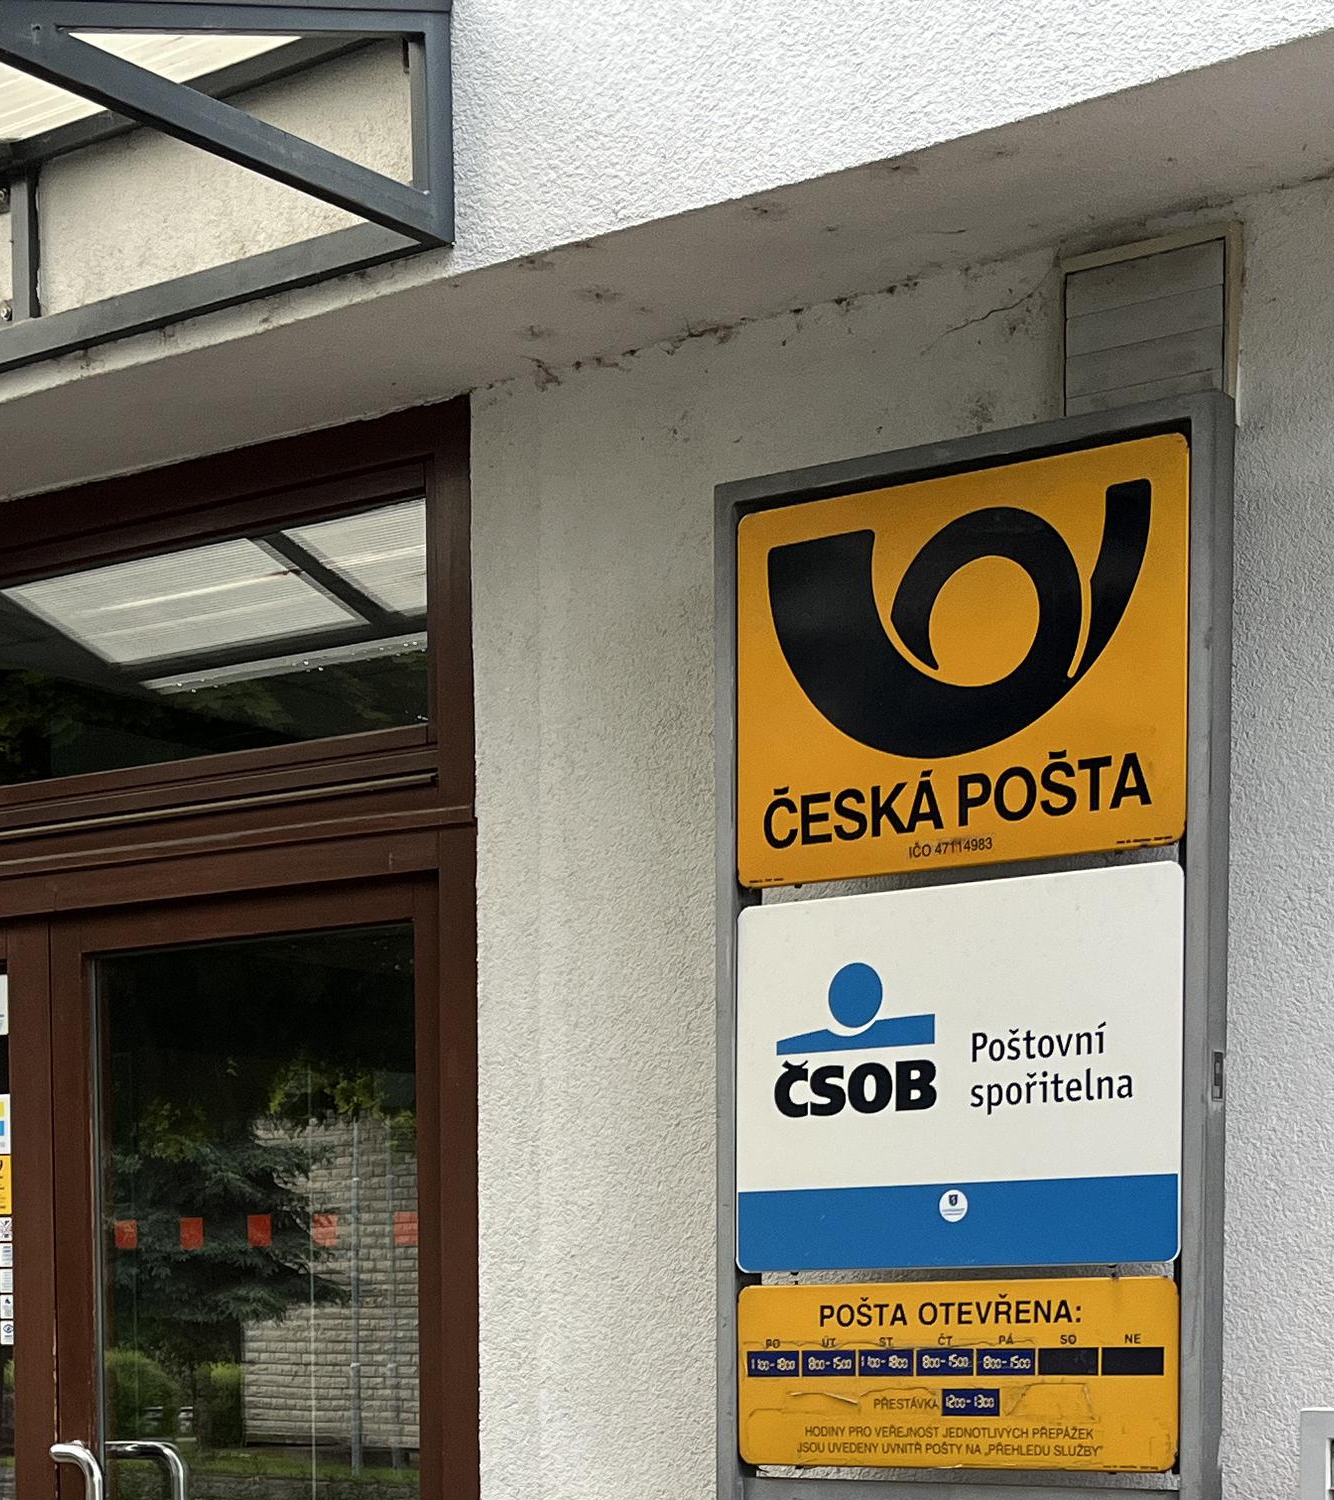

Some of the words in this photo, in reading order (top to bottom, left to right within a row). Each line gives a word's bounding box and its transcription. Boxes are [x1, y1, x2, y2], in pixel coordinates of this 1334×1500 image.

[764, 770, 944, 850] ČESKÁ
[958, 750, 1153, 827] POŠTA
[909, 842, 931, 858] IČO
[935, 837, 993, 855] 47114983
[971, 1022, 1106, 1063] Poštovní
[774, 1060, 937, 1118] ČSOB
[970, 1068, 1133, 1115] spořitelna
[820, 1297, 907, 1328] POŠTA
[919, 1293, 1082, 1326] OTEVŘENA:
[879, 1336, 893, 1347] ST
[938, 1333, 952, 1345] ČT
[998, 1332, 1014, 1345] PÁ
[1060, 1335, 1076, 1344] SO
[1125, 1334, 1141, 1344] NE
[873, 1397, 939, 1410] PŘESTÁVKA
[805, 1426, 846, 1437] HODINY
[849, 1426, 872, 1437] PRO
[875, 1424, 939, 1438] VEŘEJNOST
[943, 1424, 1028, 1438] JEDNOTLIVÝCH
[1032, 1425, 1094, 1440] PŘEPÁŽEK
[797, 1441, 825, 1453] JSOU
[828, 1441, 878, 1454] UVEDENY
[882, 1441, 922, 1454] UVNITŘ
[925, 1441, 962, 1455] POŠTY
[965, 1443, 981, 1455] NA
